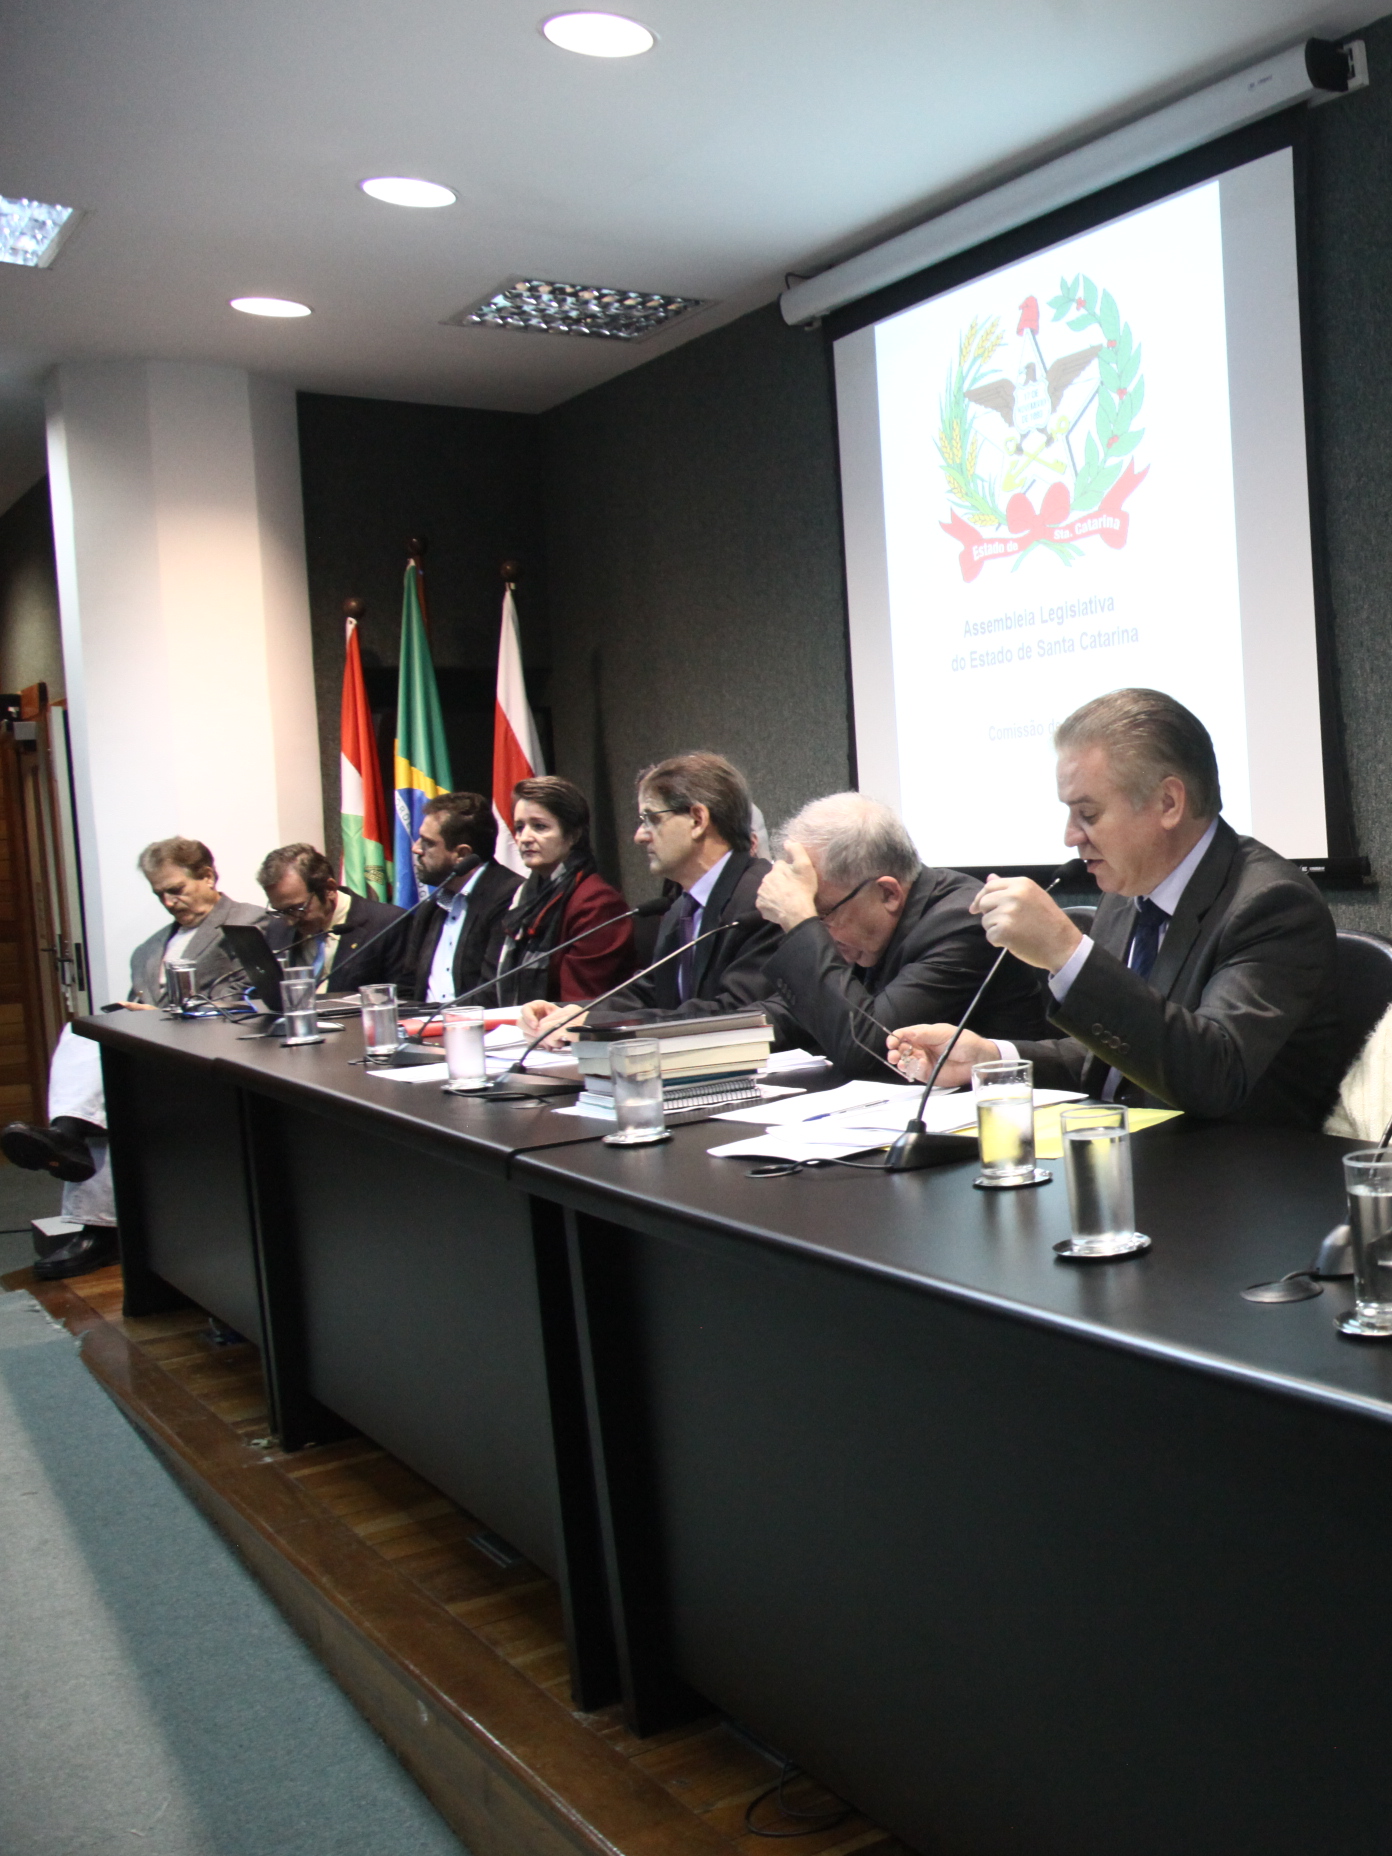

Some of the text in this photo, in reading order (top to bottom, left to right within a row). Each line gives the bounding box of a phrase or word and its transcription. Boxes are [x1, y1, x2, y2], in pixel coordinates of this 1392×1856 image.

[1053, 514, 1120, 540] Sta. Catarina
[972, 540, 1018, 561] Estado de
[964, 595, 1115, 638] Assembleia Legislativa
[951, 626, 1139, 672] do Estado de Santa Catarina
[988, 719, 1044, 742] Comissão
